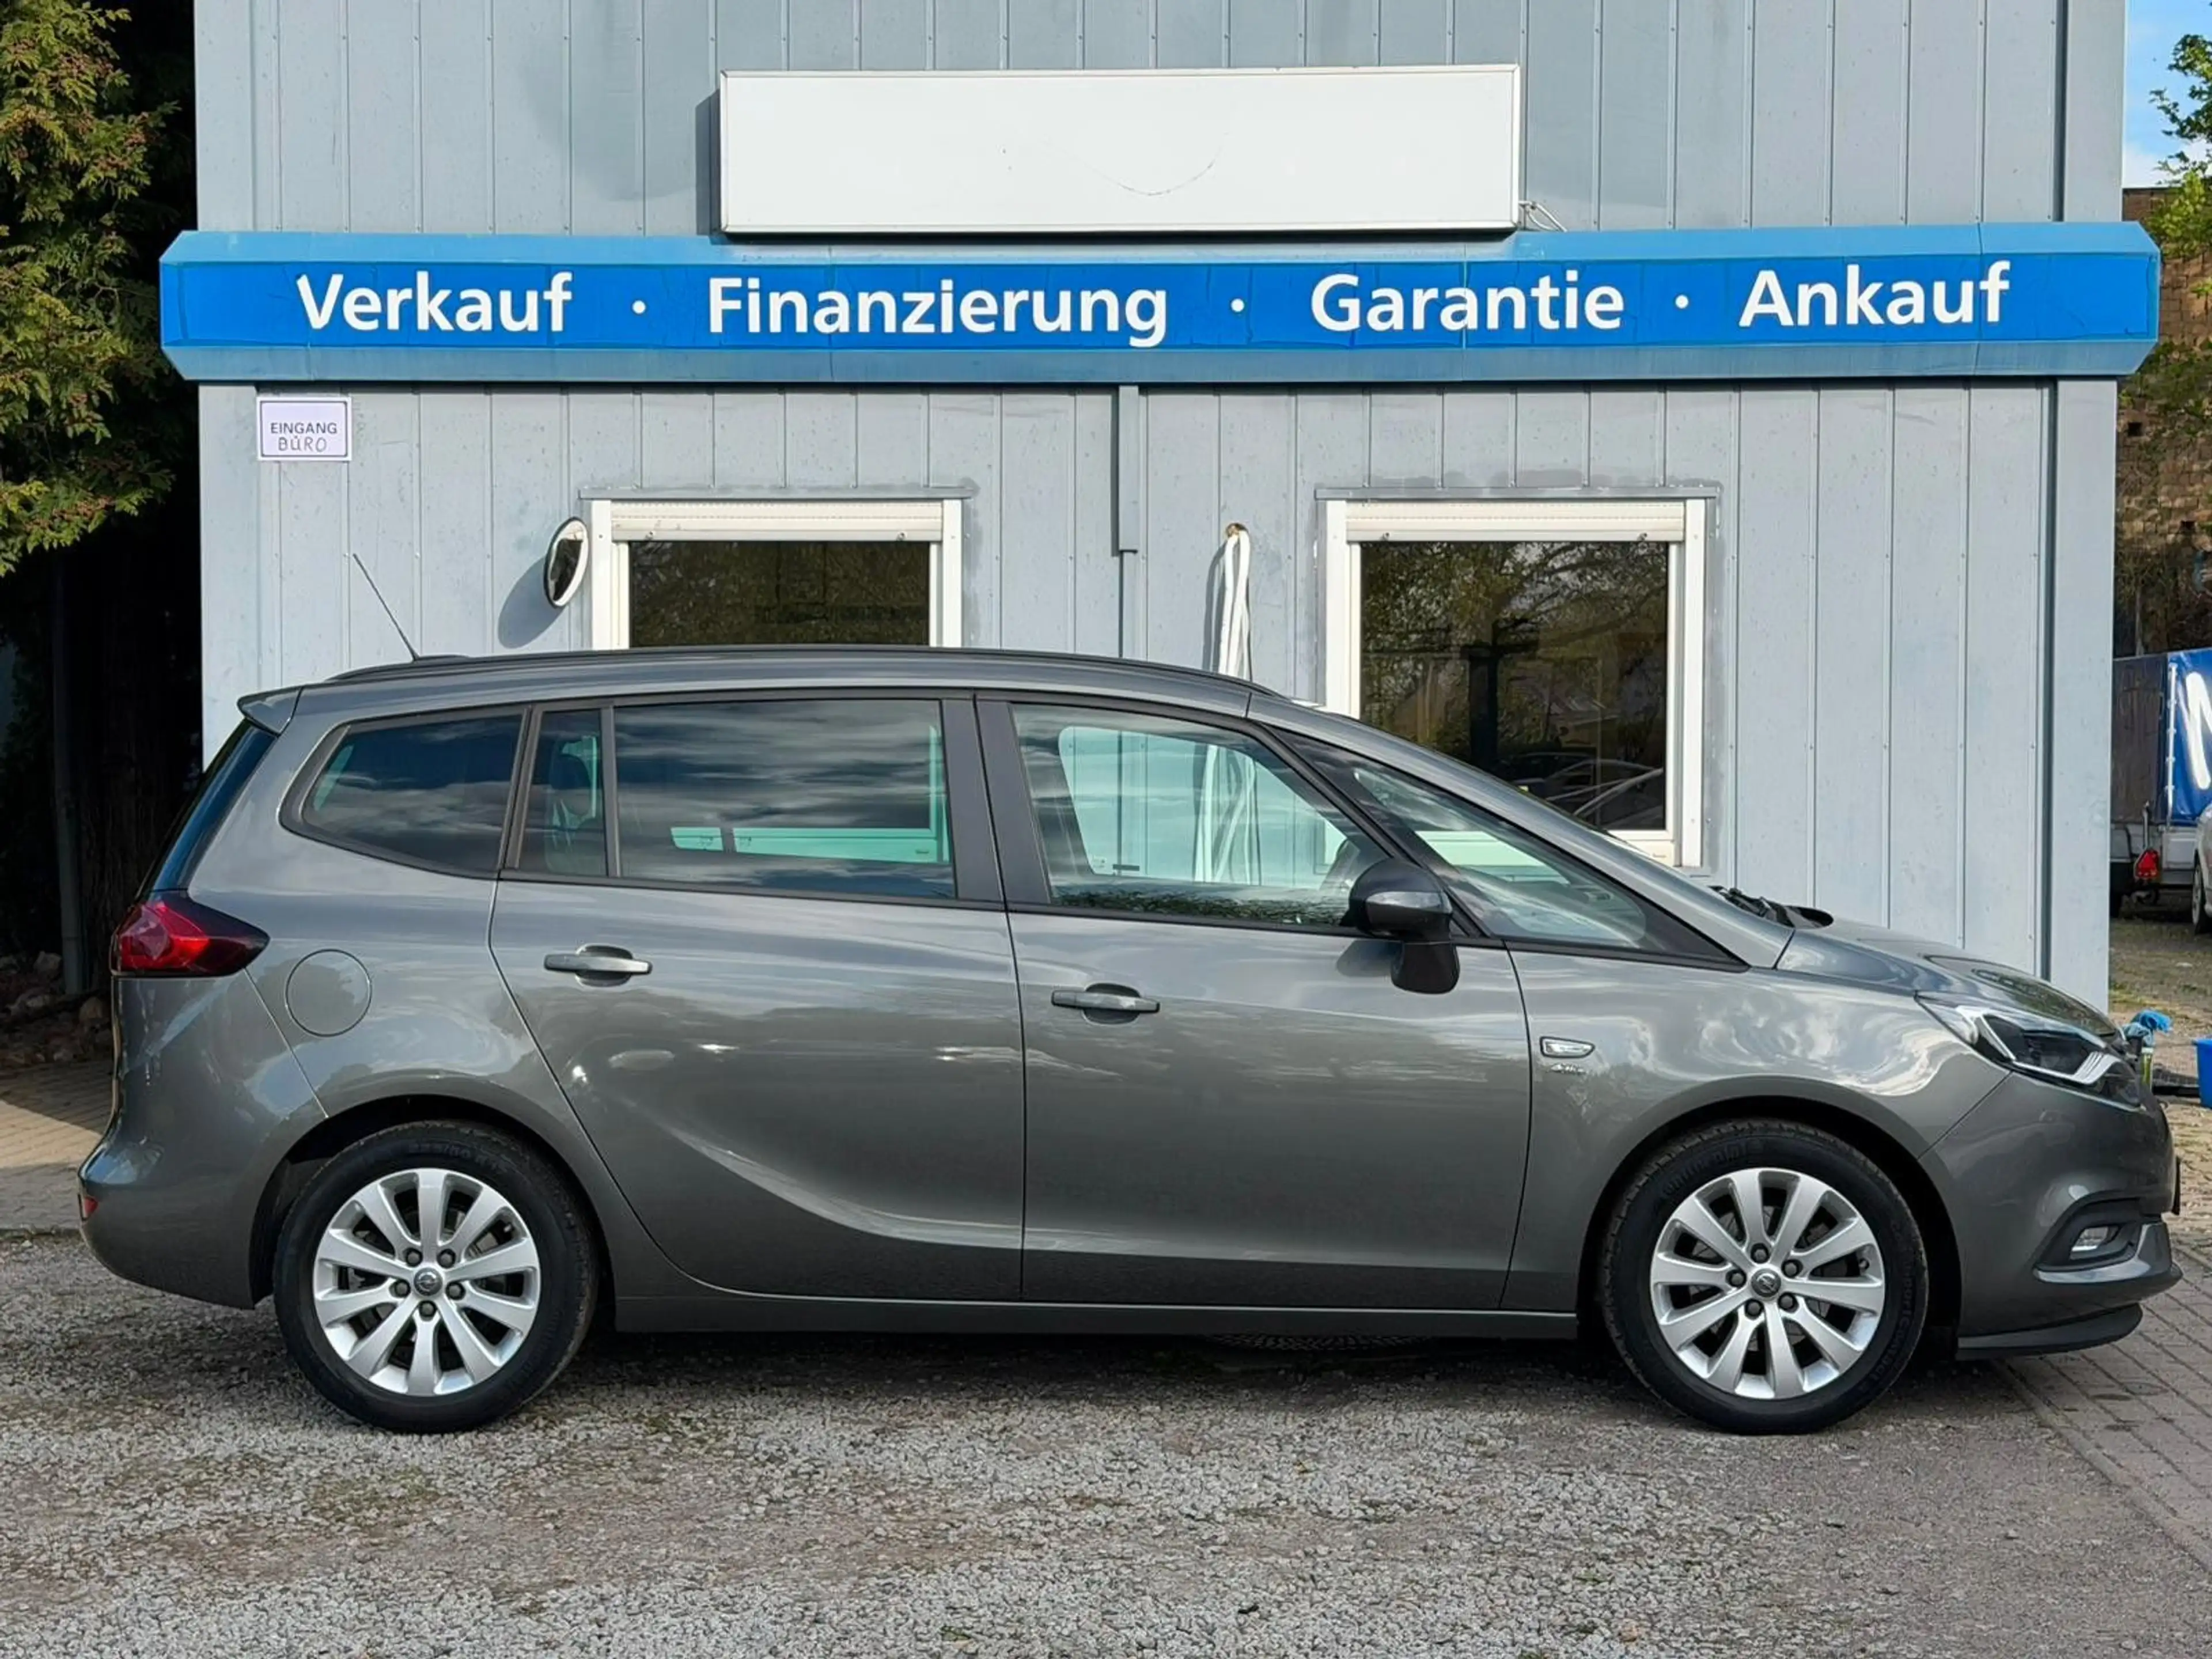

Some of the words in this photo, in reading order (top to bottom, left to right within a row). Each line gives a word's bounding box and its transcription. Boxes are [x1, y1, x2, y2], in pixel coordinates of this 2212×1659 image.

[297, 271, 572, 332] Verkauf
[710, 278, 1166, 347] Finanzierung
[1312, 270, 1624, 331] Garantie
[1740, 261, 2010, 327] Ankauf
[270, 422, 337, 434] EINGANG
